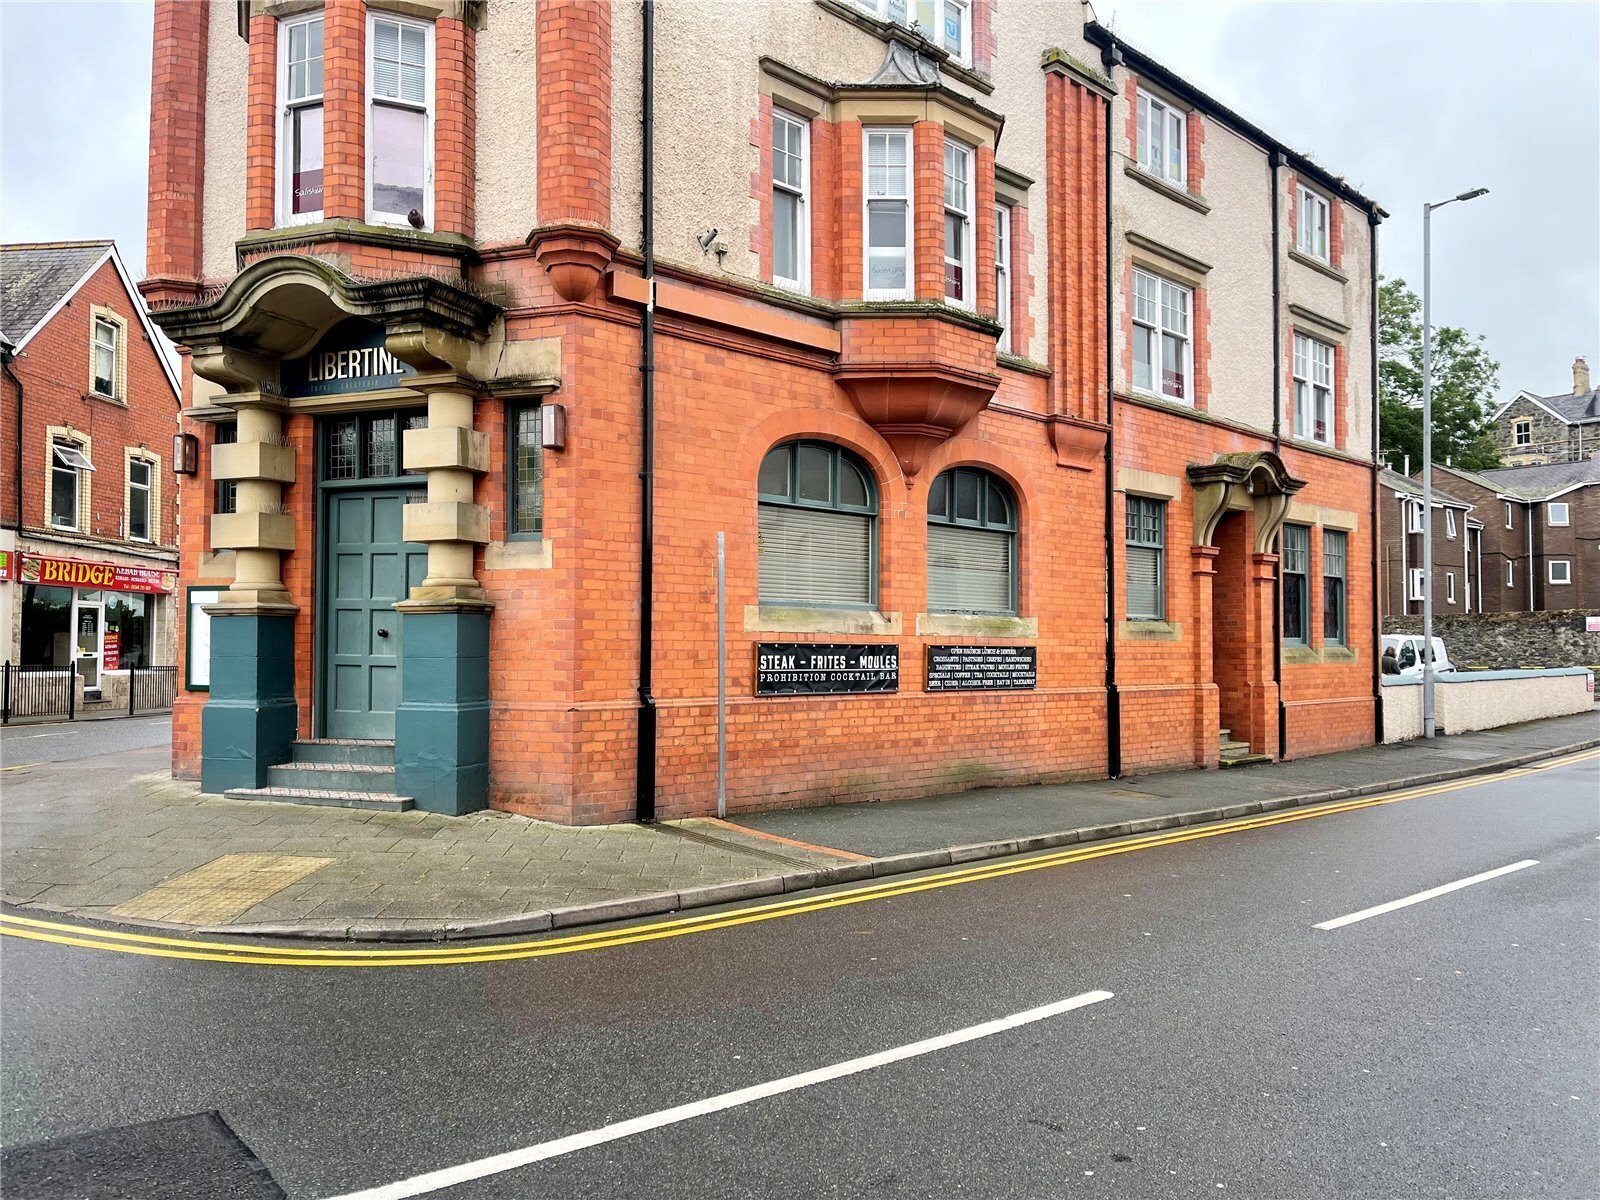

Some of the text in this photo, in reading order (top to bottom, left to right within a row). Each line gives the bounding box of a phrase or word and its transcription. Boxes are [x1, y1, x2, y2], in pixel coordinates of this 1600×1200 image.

[294, 185, 324, 197] Salisbur
[44, 560, 115, 586] BRIDGE
[760, 655, 796, 670] STEAK
[810, 655, 846, 669] FRITES
[860, 655, 897, 669] MOULES
[760, 672, 897, 682] PROHIBITION COCKTAIL BAR
